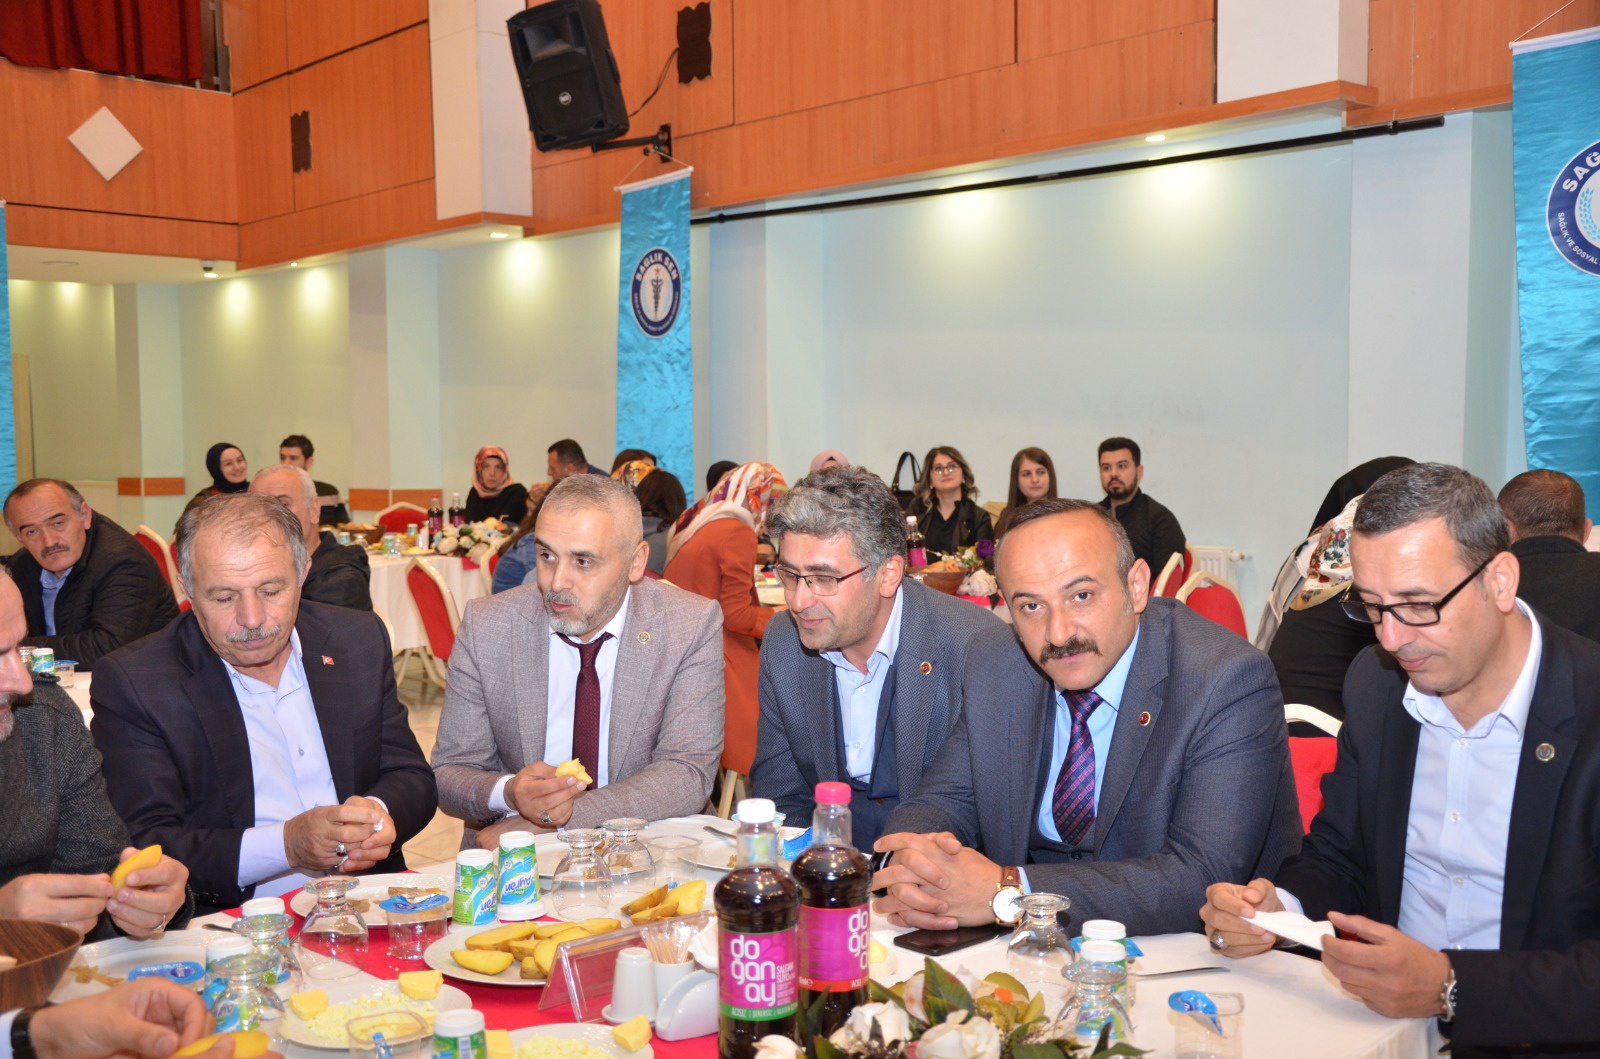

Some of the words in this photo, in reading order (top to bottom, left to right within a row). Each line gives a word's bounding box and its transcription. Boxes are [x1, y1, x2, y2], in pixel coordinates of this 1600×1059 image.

[1558, 212, 1570, 238] SAĞLIK
[1566, 236, 1575, 248] VE
[1572, 243, 1599, 266] SOSYAL
[505, 875, 532, 892] Ayran
[848, 908, 868, 933] do
[730, 934, 760, 960] do
[731, 958, 775, 986] ğan
[745, 982, 777, 1008] ay
